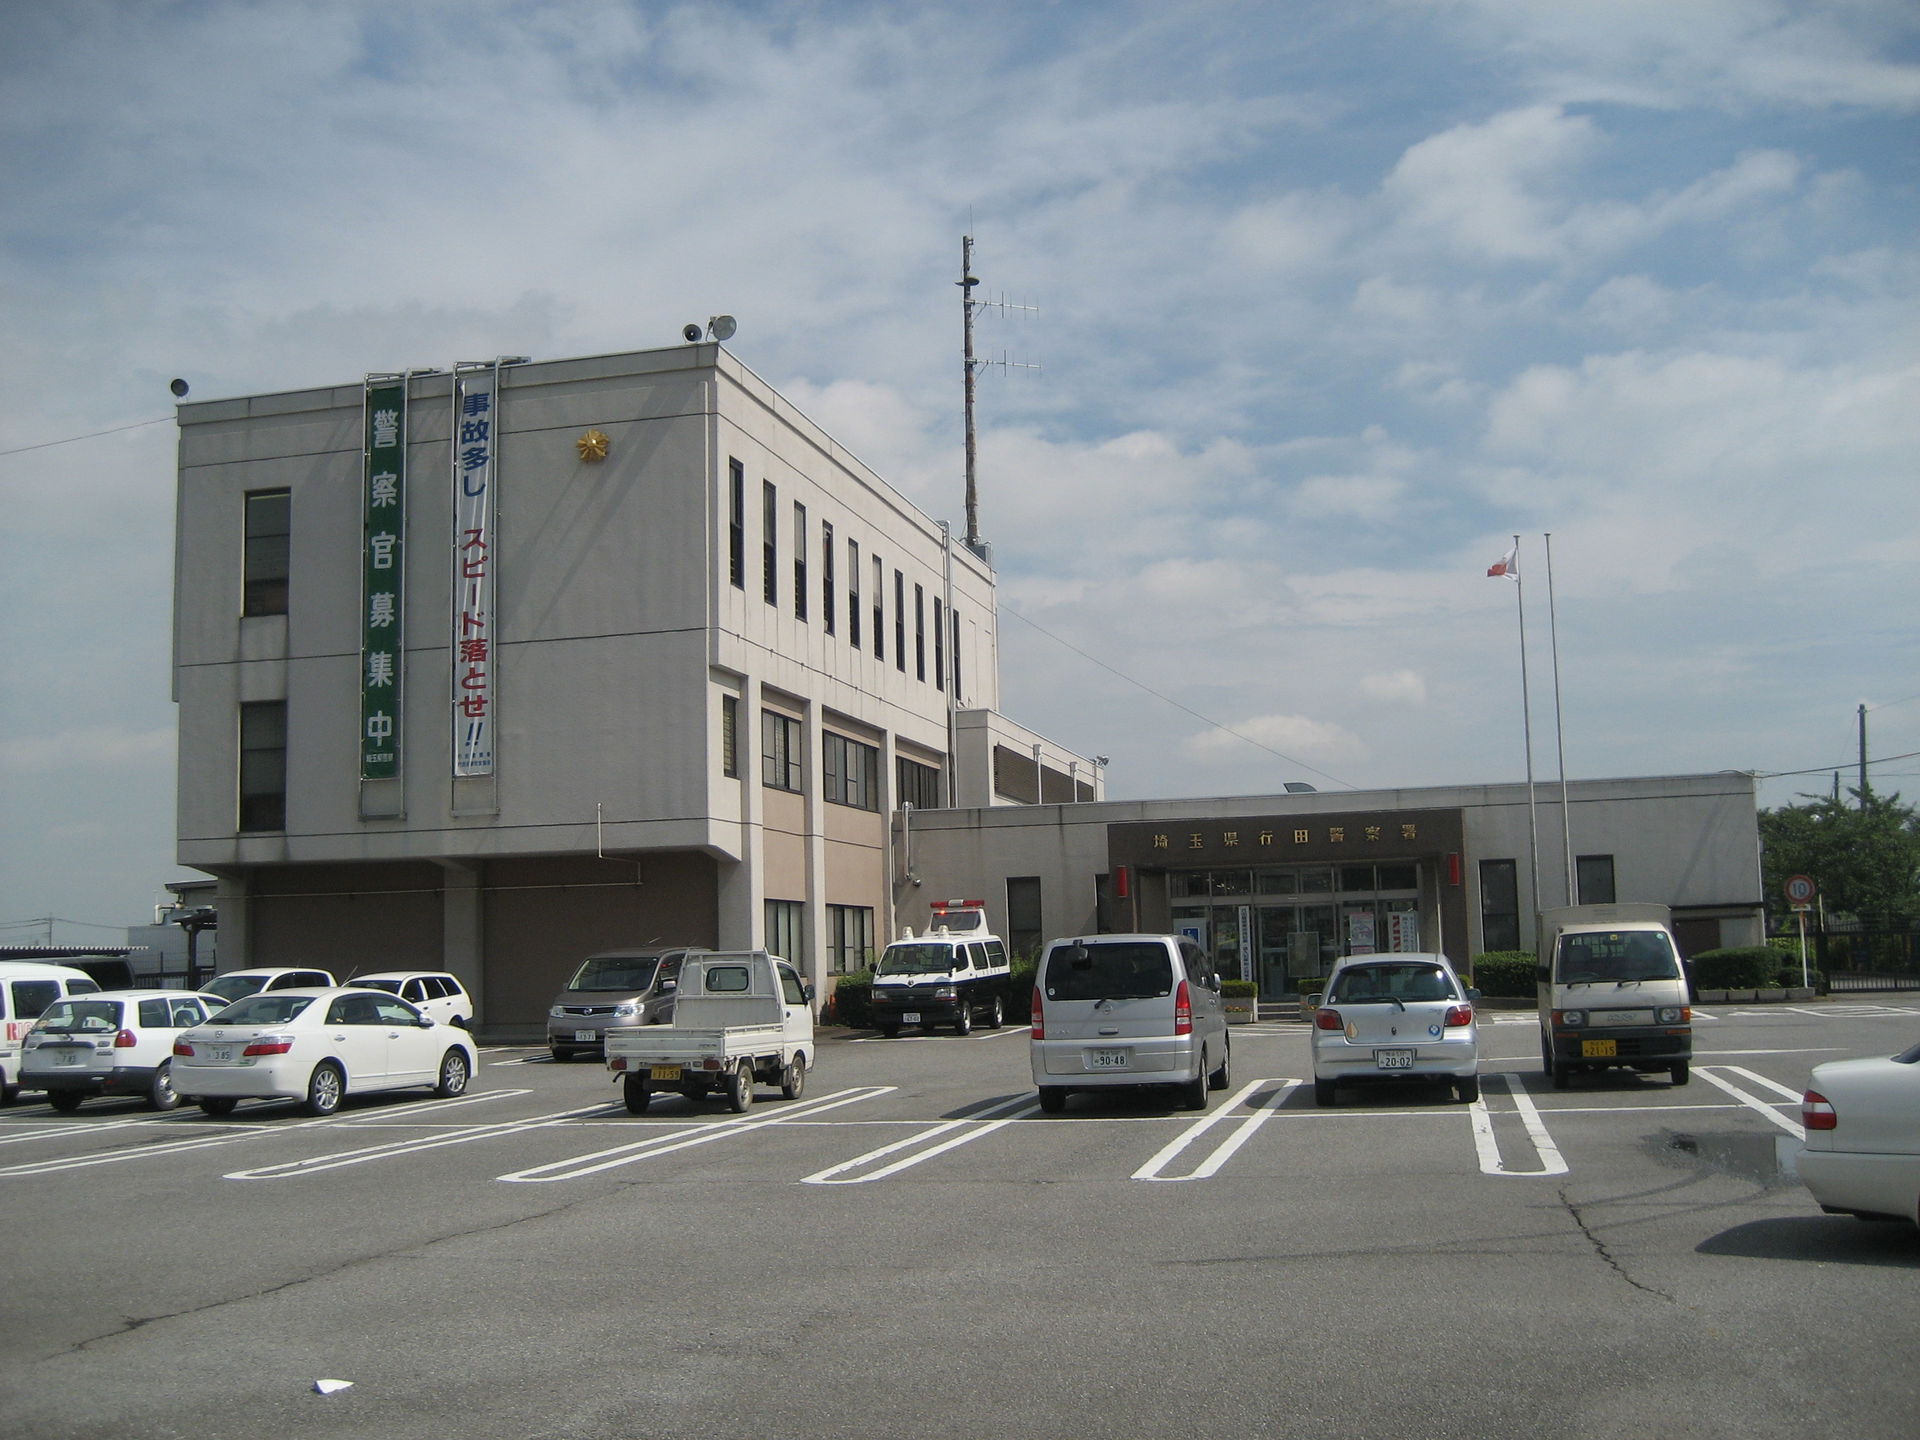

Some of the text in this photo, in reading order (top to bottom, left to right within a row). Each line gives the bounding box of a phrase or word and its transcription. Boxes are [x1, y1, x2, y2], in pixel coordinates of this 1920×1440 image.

[461, 392, 491, 498] 事故多し
[367, 408, 399, 747] 警察官募集中
[1152, 823, 1418, 850] 埼玉県行田警察署
[1792, 882, 1807, 897] 10
